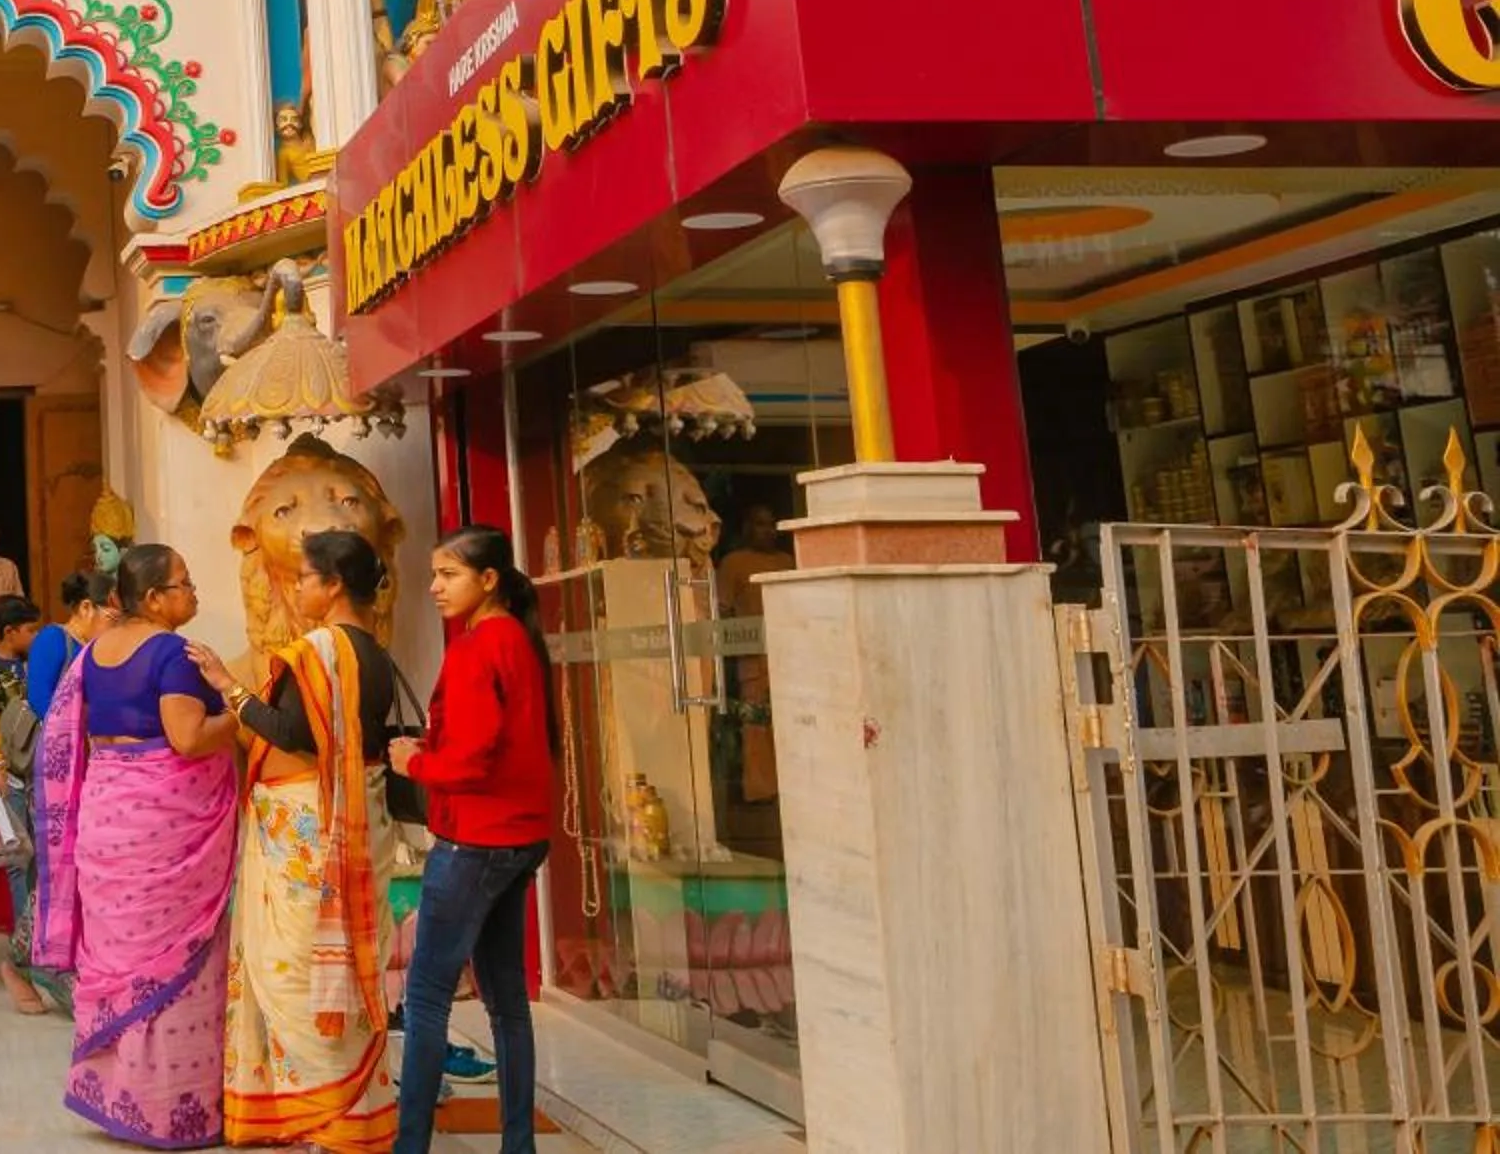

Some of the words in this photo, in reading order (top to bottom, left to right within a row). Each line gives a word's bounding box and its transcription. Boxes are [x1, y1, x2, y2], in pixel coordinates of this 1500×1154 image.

[448, 46, 475, 97] HARE
[474, 0, 519, 70] KRISHNA
[343, 57, 540, 314] MATCHLESS
